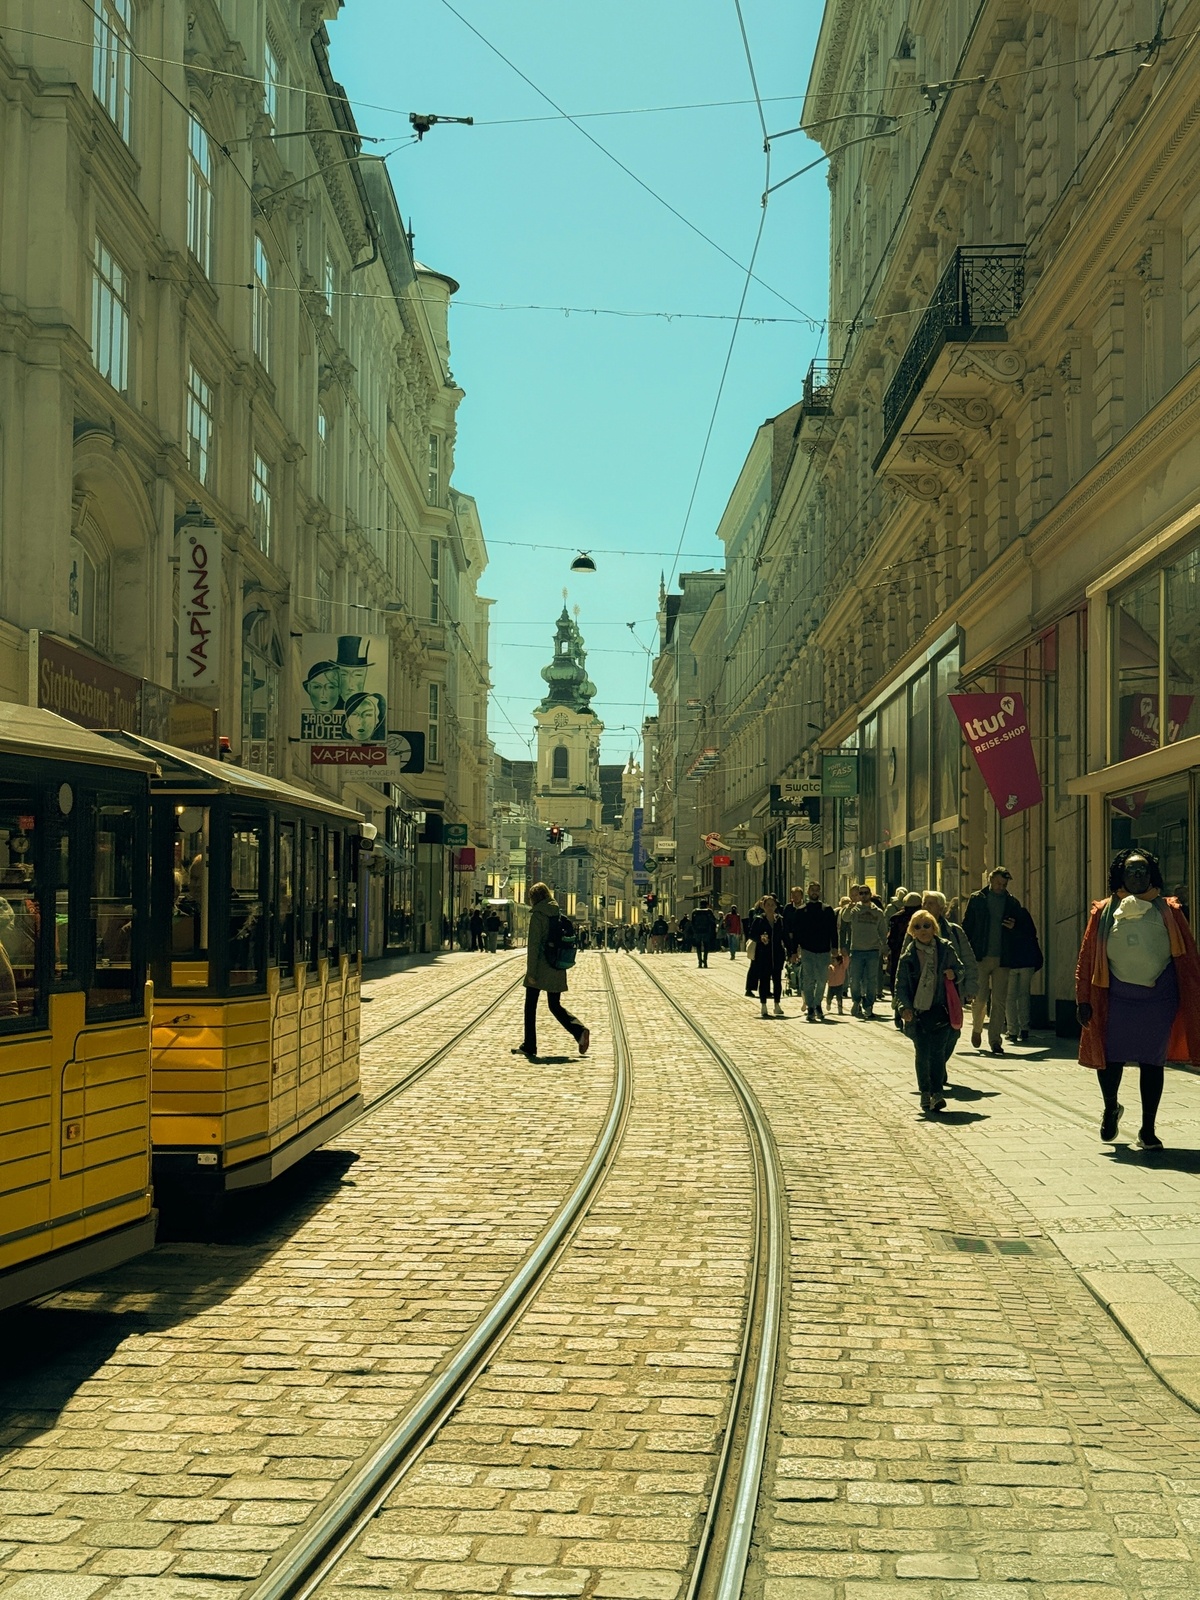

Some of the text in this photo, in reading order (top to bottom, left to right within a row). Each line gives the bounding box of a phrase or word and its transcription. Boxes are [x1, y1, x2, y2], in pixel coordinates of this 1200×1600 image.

[303, 714, 343, 724] JANOUT
[303, 724, 342, 739] HÜTE
[974, 725, 1026, 754] REISE-SHOP
[345, 769, 396, 777] FEICHTINGER
[832, 765, 852, 778] FASS
[785, 783, 821, 792] swatc
